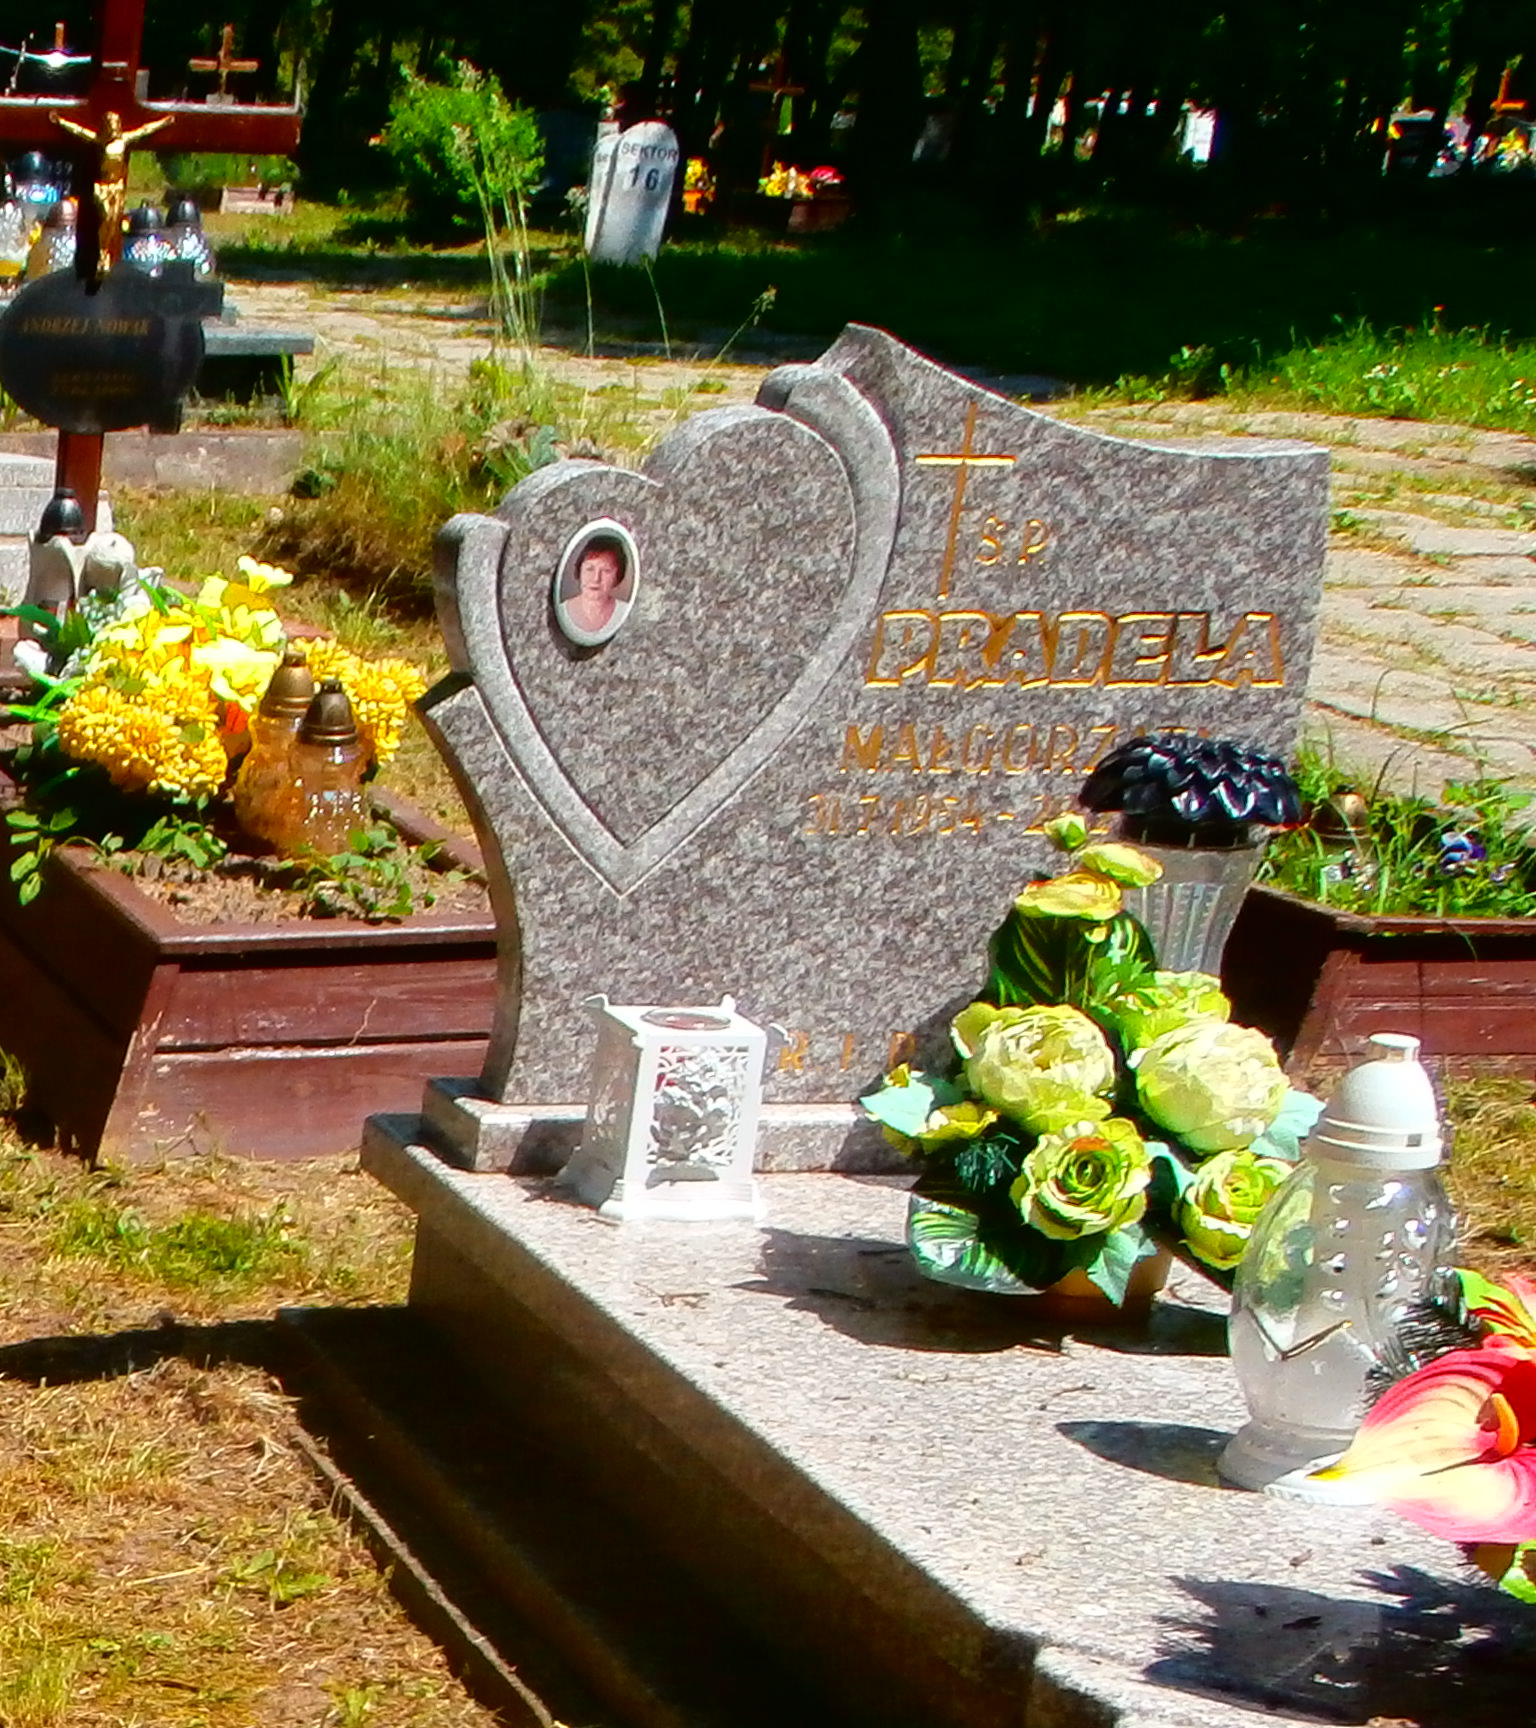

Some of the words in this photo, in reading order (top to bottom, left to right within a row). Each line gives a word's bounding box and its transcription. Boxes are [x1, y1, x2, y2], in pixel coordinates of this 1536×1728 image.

[621, 142, 678, 161] SEKTOR
[630, 164, 659, 190] 16
[864, 608, 1285, 690] PRADELA
[839, 722, 1211, 775] MAŁGORZ
